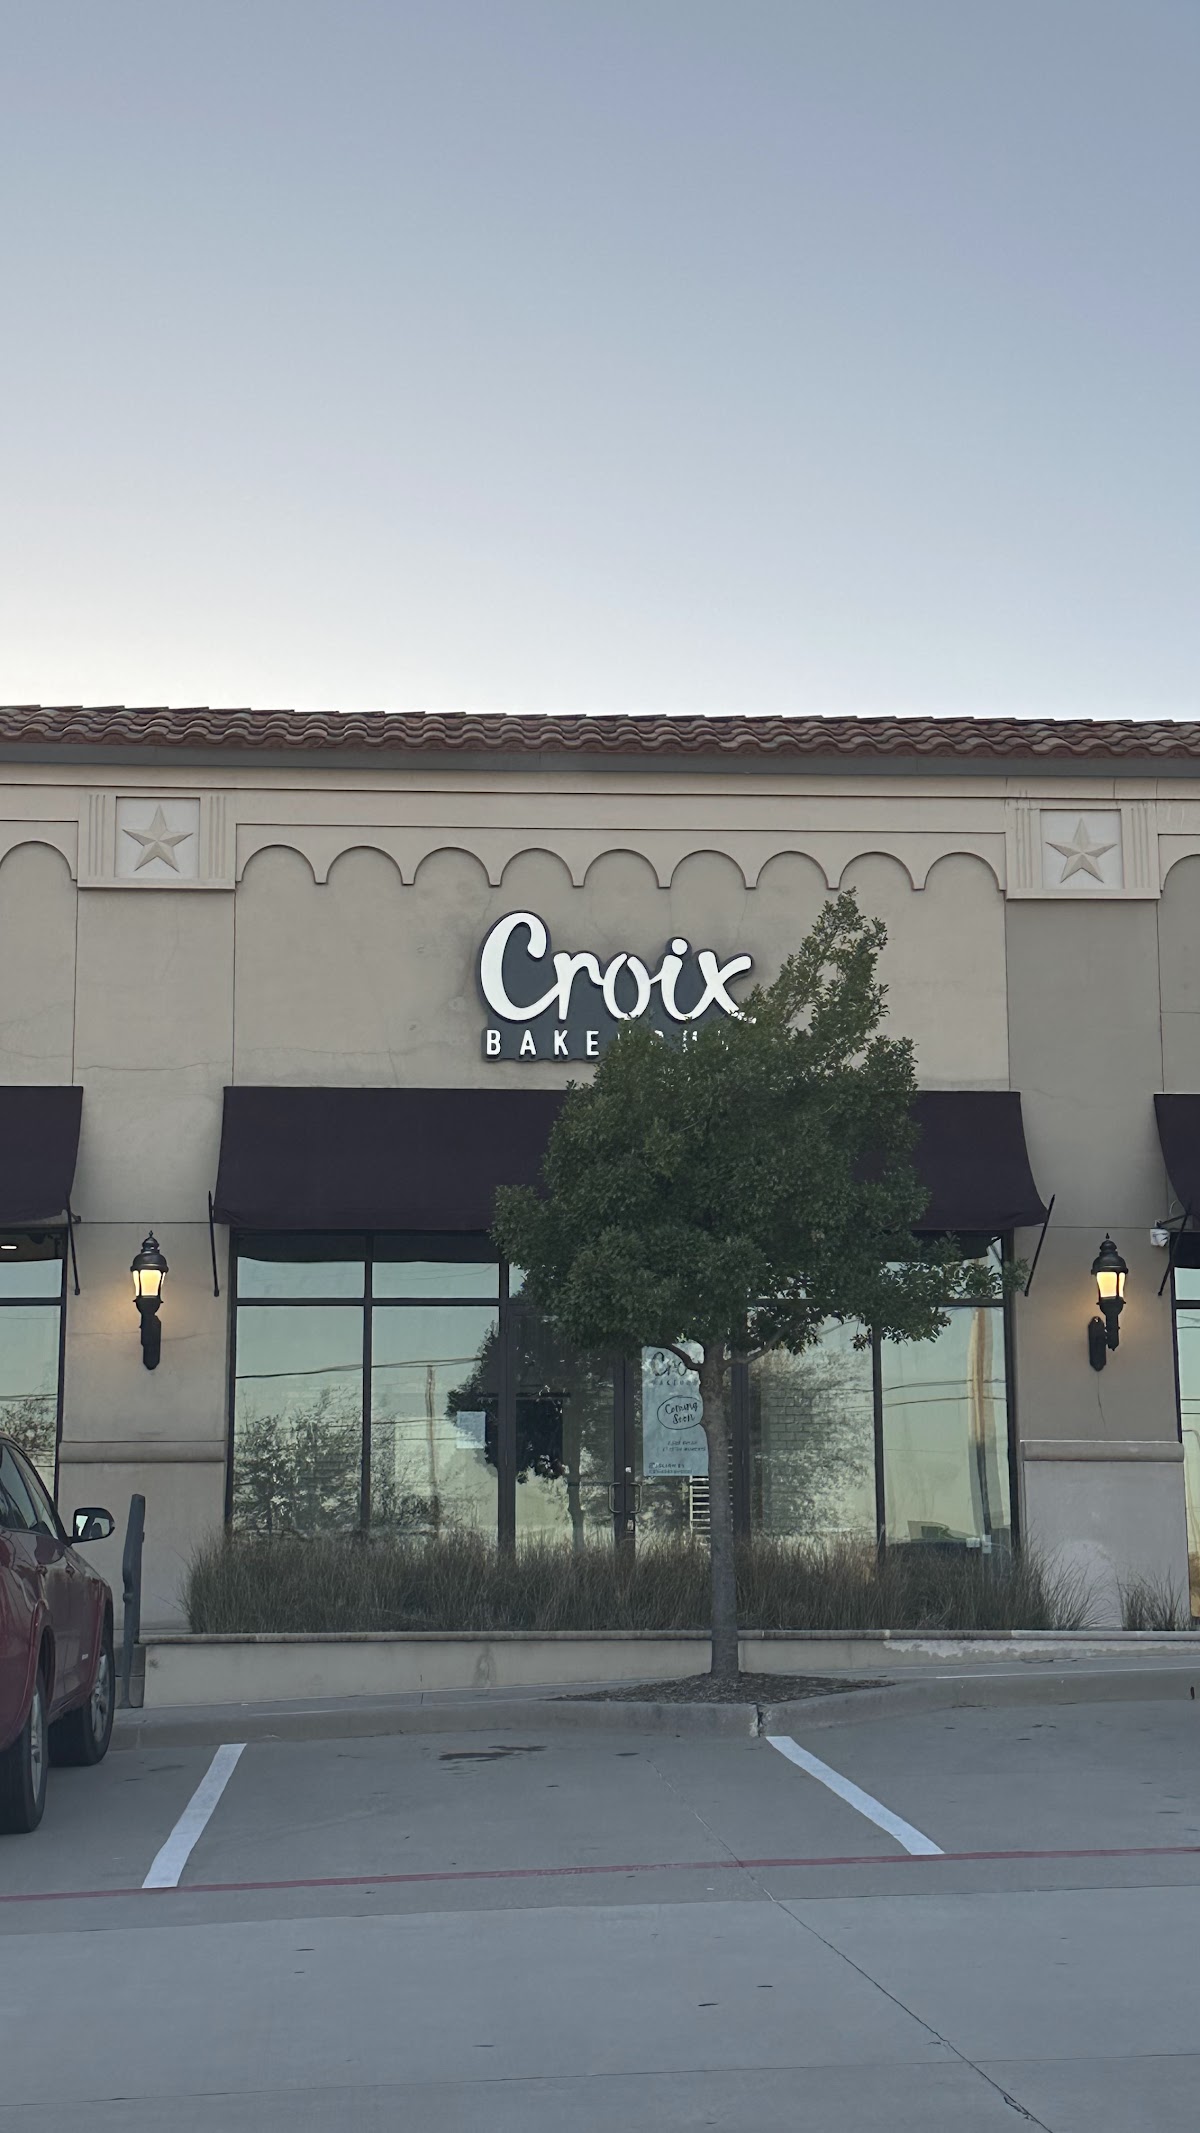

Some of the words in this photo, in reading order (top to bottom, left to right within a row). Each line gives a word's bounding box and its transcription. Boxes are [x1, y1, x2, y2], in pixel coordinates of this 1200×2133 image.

[480, 912, 757, 1023] Croix
[650, 1351, 687, 1377] Cro
[665, 1402, 698, 1415] Coming
[672, 1413, 696, 1425] Soon
